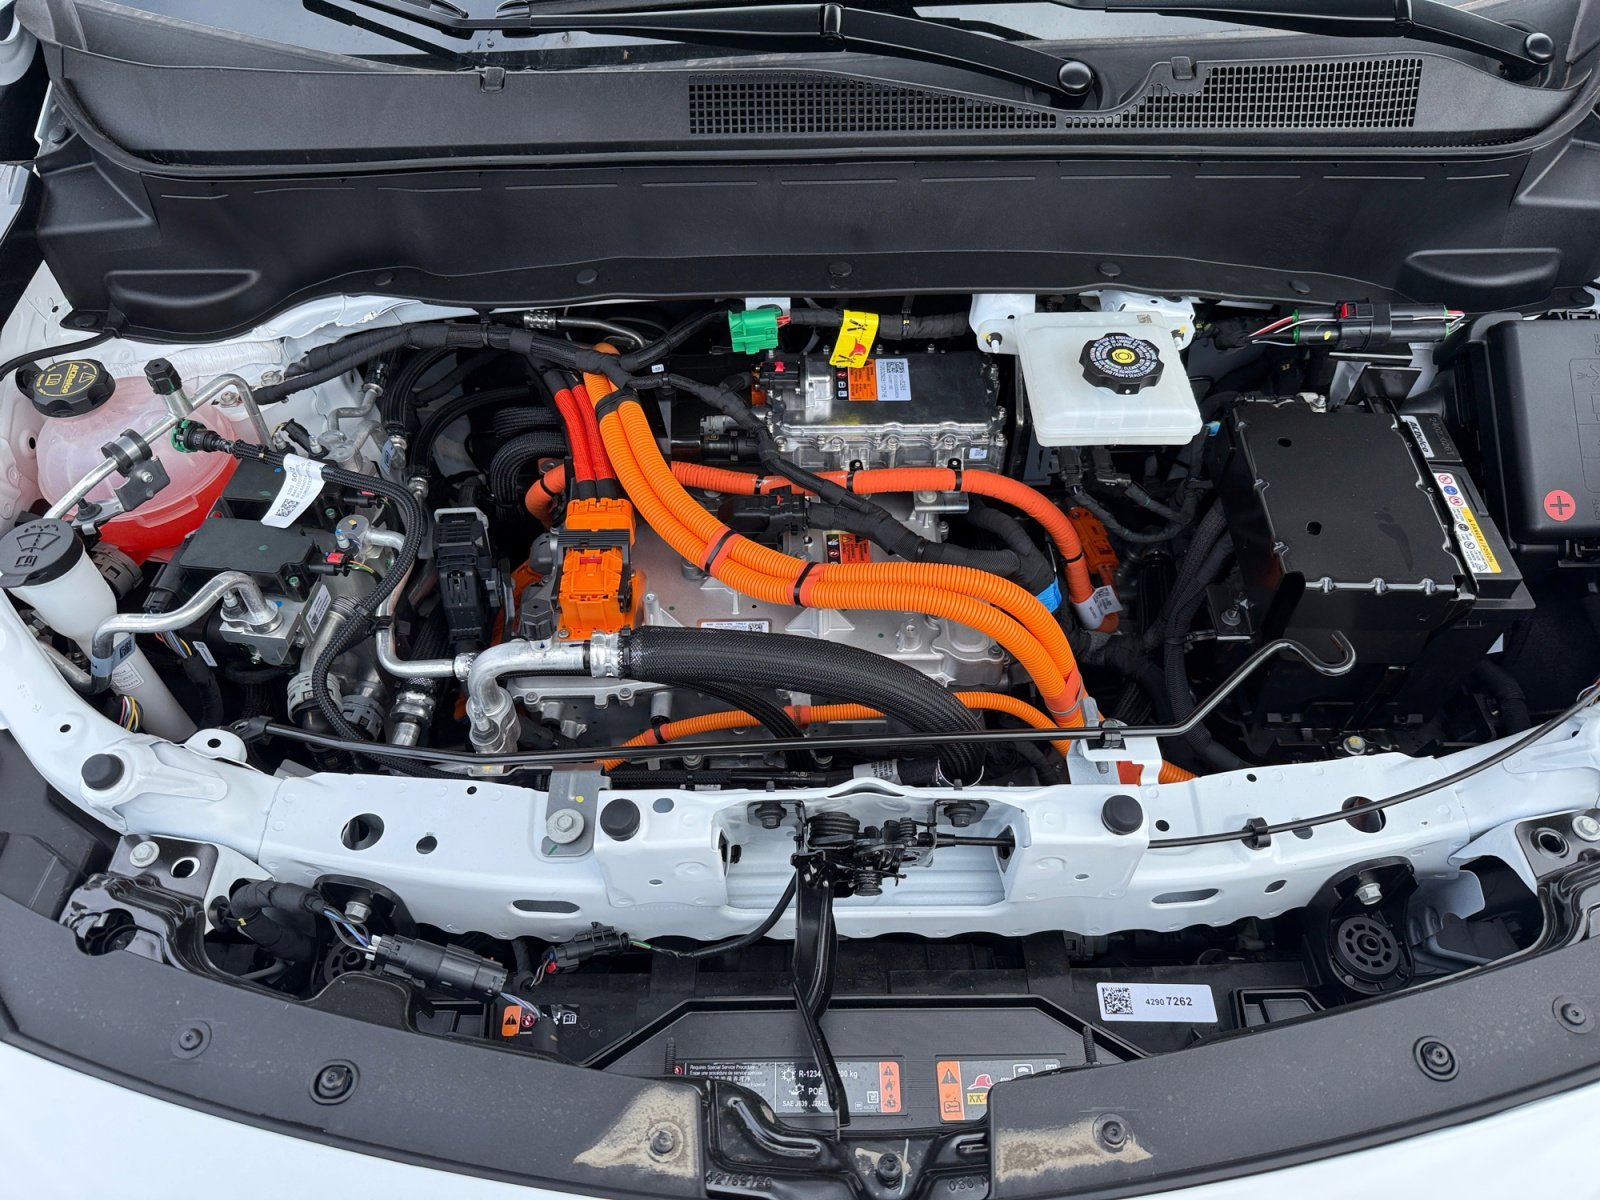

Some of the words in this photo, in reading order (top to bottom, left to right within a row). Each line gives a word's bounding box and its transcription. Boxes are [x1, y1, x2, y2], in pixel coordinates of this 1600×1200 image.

[1409, 421, 1429, 453] ACDelco
[1146, 998, 1164, 1006] 4290
[1166, 996, 1192, 1006] 7262
[798, 1070, 821, 1078] R-1234
[849, 1070, 858, 1079] kg
[808, 1087, 823, 1095] POE
